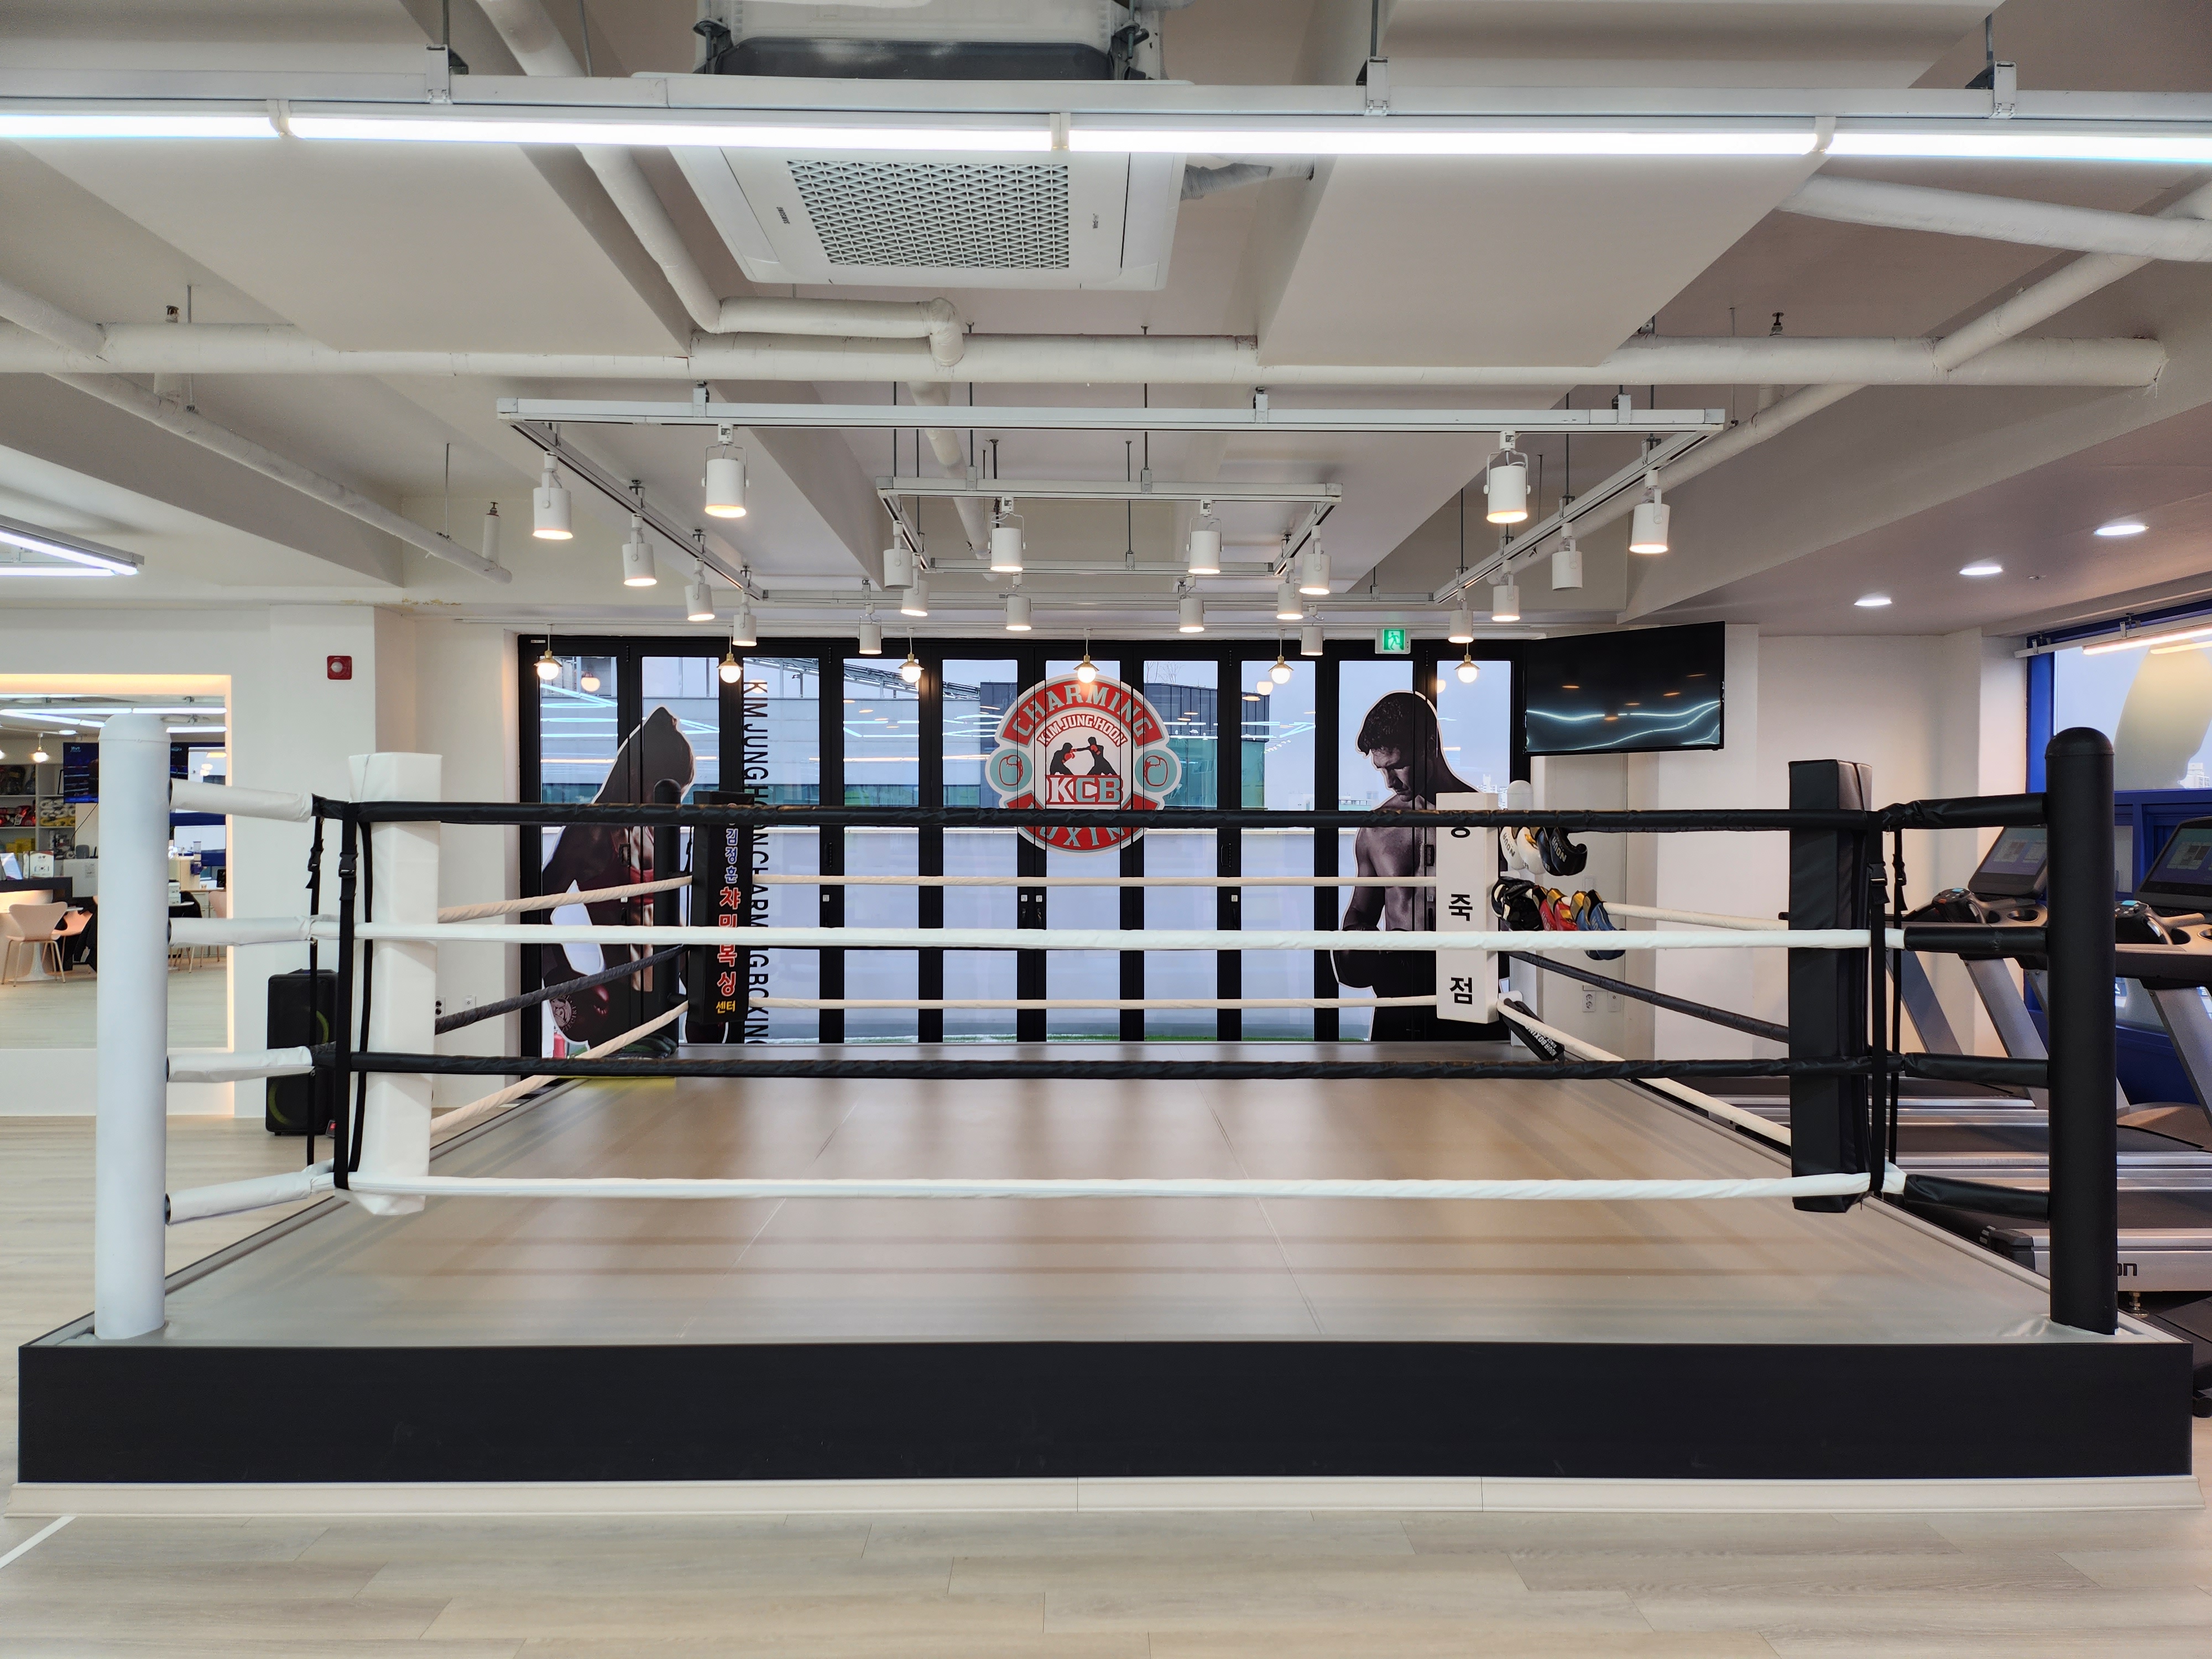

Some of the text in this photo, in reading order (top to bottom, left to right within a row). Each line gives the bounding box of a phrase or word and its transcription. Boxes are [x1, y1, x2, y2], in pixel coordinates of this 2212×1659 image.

[743, 681, 768, 718] KIM
[1013, 684, 1153, 738] CHARMING
[1039, 714, 1128, 747] KIM JUNG HOON
[743, 723, 769, 781] JUNG
[1048, 776, 1123, 804] KCB
[724, 828, 739, 884] 김정훈
[716, 1000, 736, 1014] 센터
